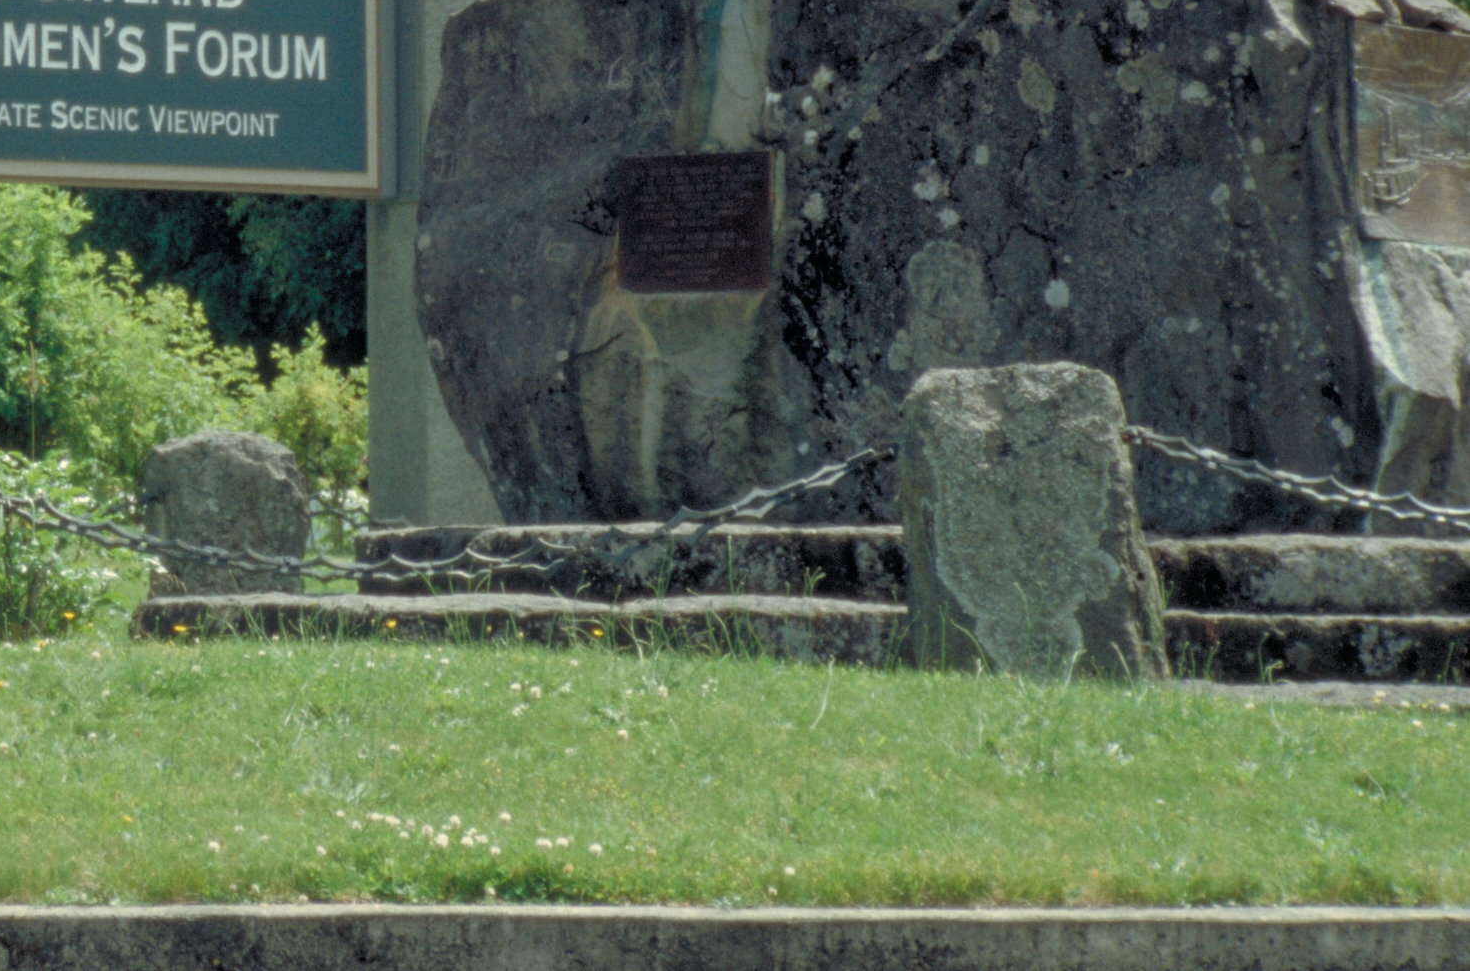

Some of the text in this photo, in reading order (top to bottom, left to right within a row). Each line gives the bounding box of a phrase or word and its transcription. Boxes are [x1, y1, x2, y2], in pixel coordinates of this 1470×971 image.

[166, 22, 327, 81] FORUM
[50, 101, 139, 132] SCENIC
[150, 106, 279, 137] VIEWPOINT
